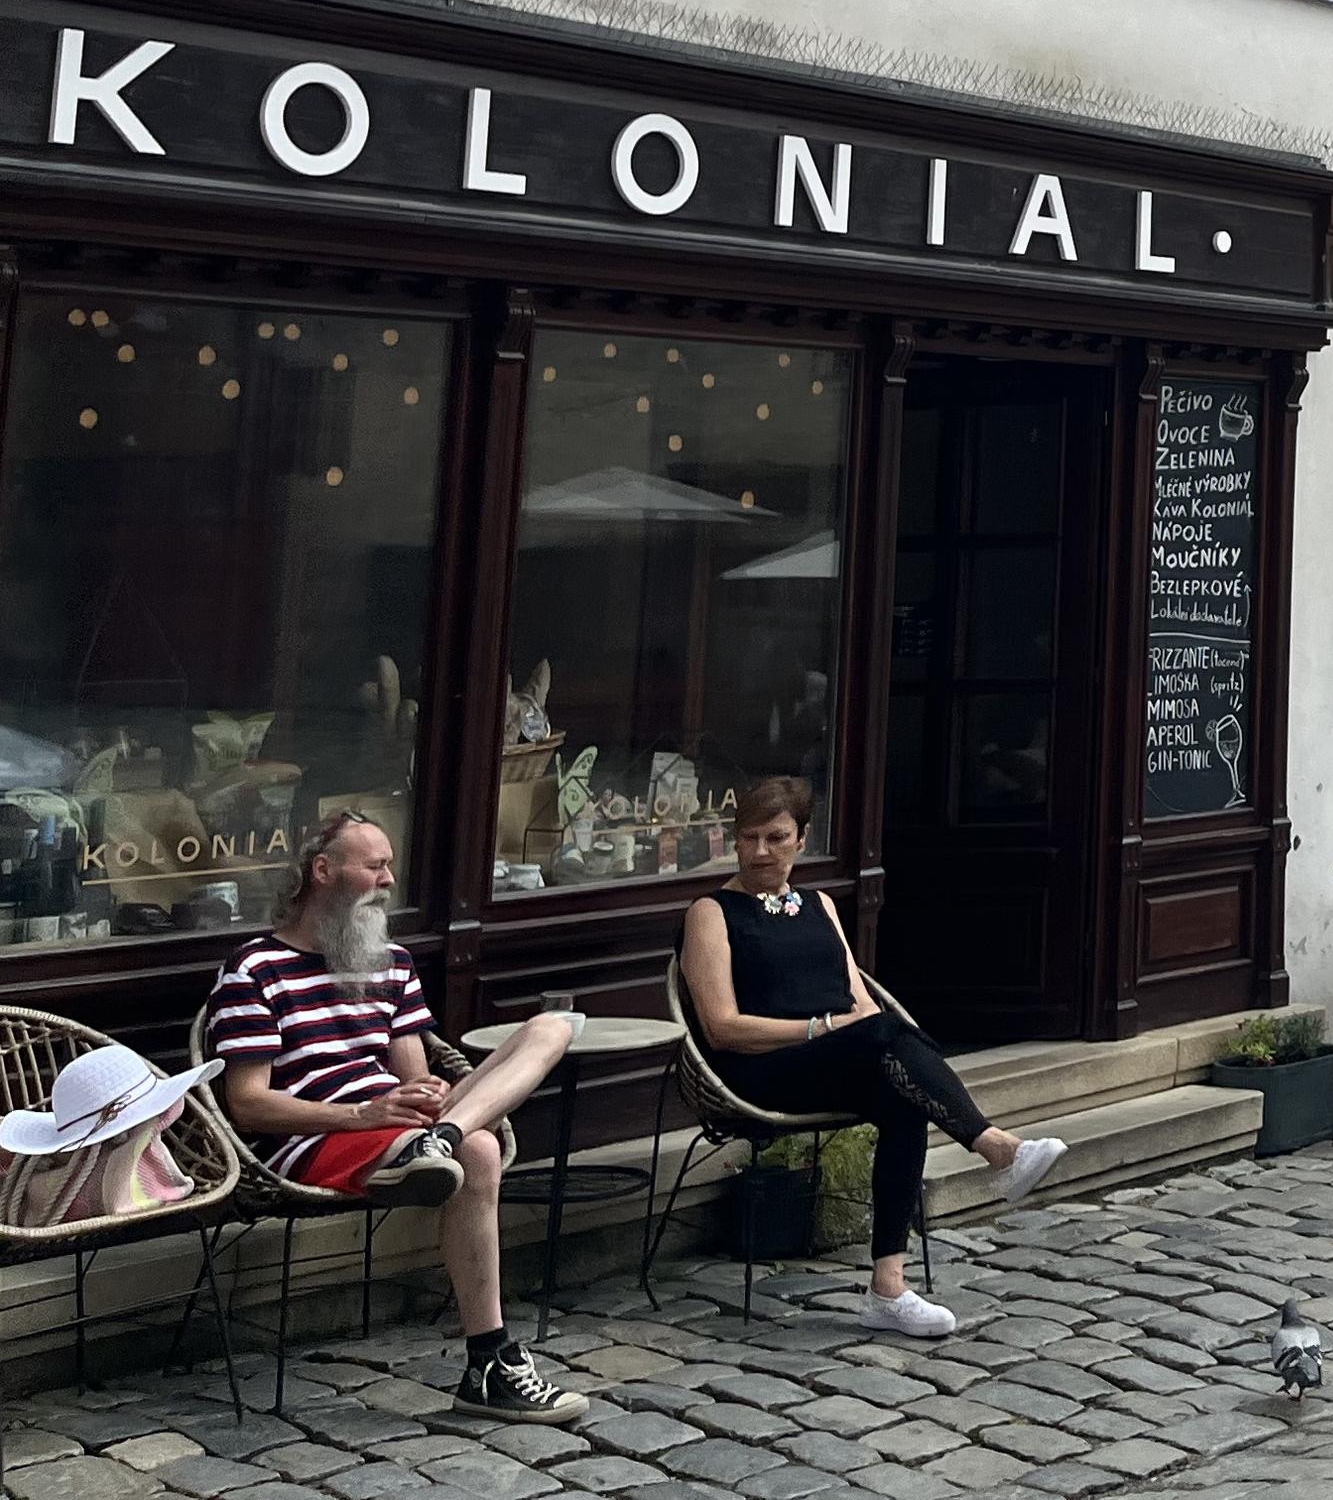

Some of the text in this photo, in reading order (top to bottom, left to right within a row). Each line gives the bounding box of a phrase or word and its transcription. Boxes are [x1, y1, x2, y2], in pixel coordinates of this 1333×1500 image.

[1155, 446, 1236, 470] ZELENINA
[1152, 519, 1213, 542] NÁPOJE
[1150, 570, 1244, 598] BEZLEPKOVÉ
[1147, 698, 1200, 721] MIMOSA
[1147, 723, 1200, 747] APEROL
[1147, 749, 1212, 773] GIN-TONIC
[82, 825, 308, 870] KOLONIA
